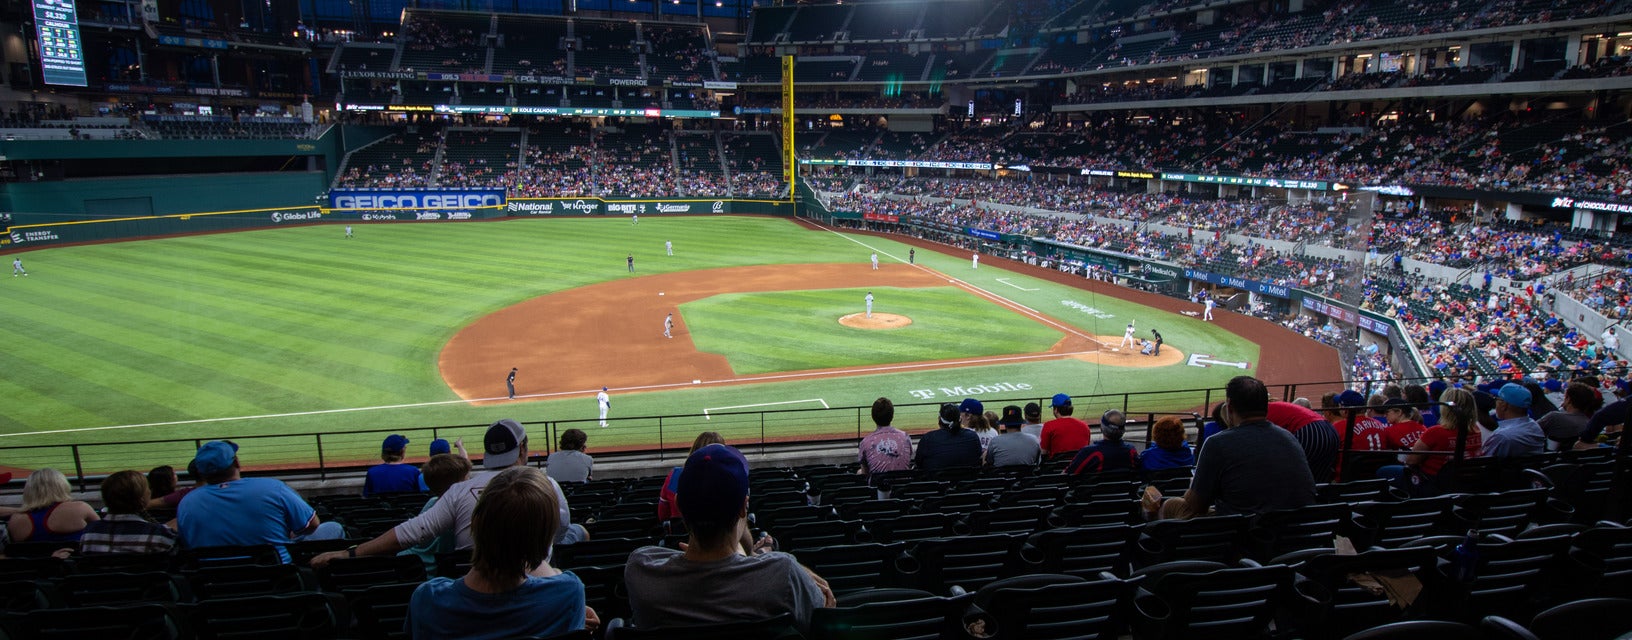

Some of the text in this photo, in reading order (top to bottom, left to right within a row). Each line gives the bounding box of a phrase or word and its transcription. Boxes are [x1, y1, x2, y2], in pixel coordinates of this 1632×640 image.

[609, 79, 648, 87] POWERADE
[335, 194, 501, 209] GEICO GEICO
[518, 202, 553, 211] National
[573, 200, 598, 214] Kroger
[608, 204, 621, 212] BIG
[307, 211, 322, 219] Life
[1193, 270, 1208, 281] Mitel
[1228, 278, 1245, 288] Mitel
[1268, 285, 1287, 296] Mitel
[937, 382, 1033, 397] Mobile
[1367, 433, 1381, 451] 11
